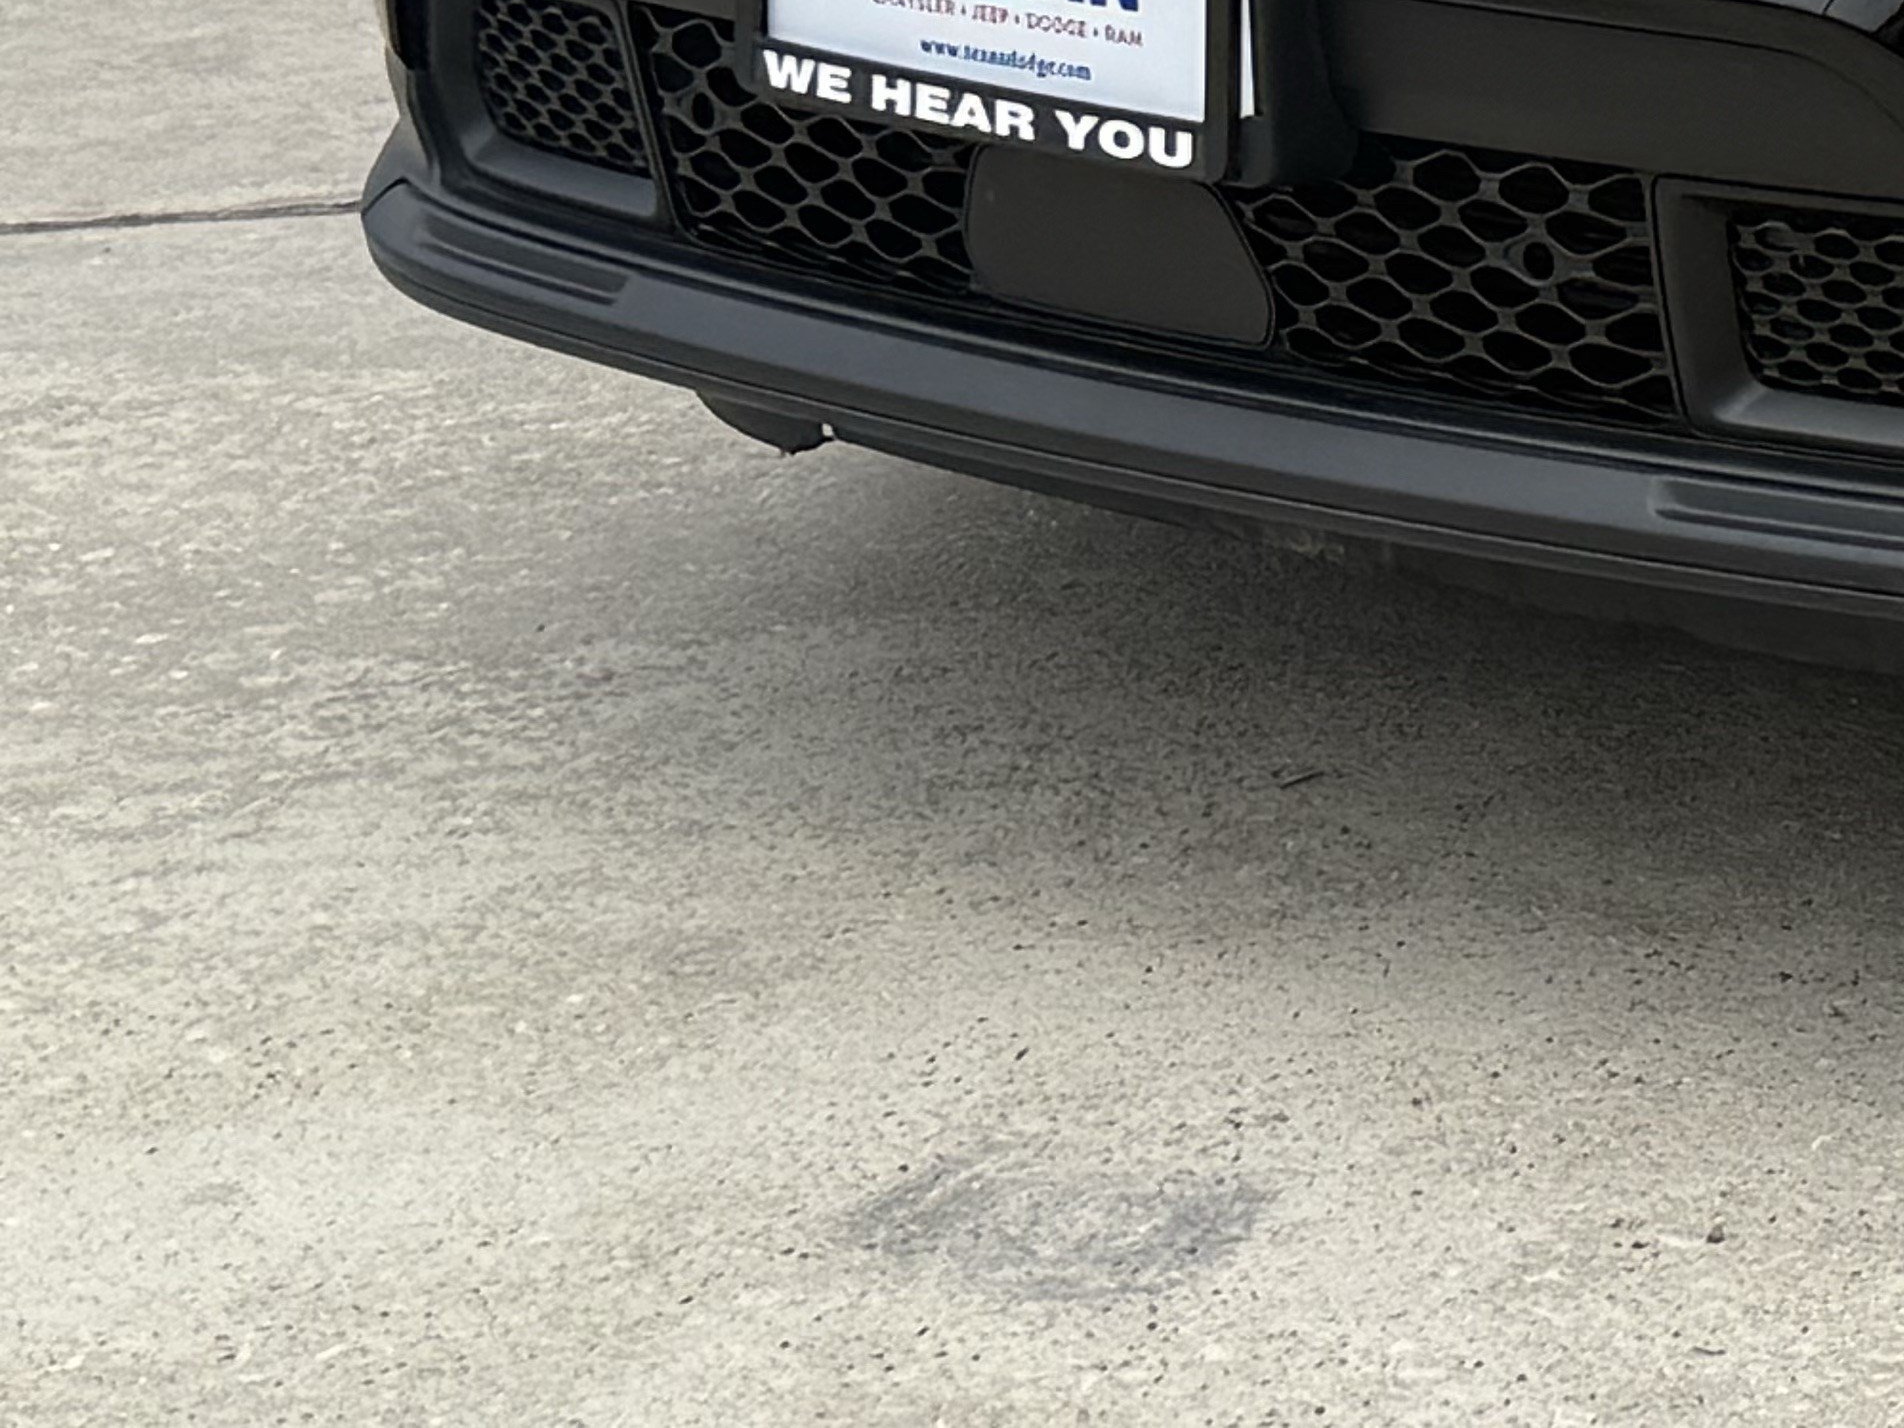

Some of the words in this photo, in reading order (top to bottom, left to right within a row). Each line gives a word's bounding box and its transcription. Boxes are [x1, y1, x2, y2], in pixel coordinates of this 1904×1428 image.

[971, 4, 1010, 25] JEEP
[1025, 11, 1088, 39] DODGE
[1104, 23, 1144, 47] RAM
[762, 48, 852, 104] WE
[871, 72, 1037, 142] HEAR
[1054, 107, 1195, 169] YOU
